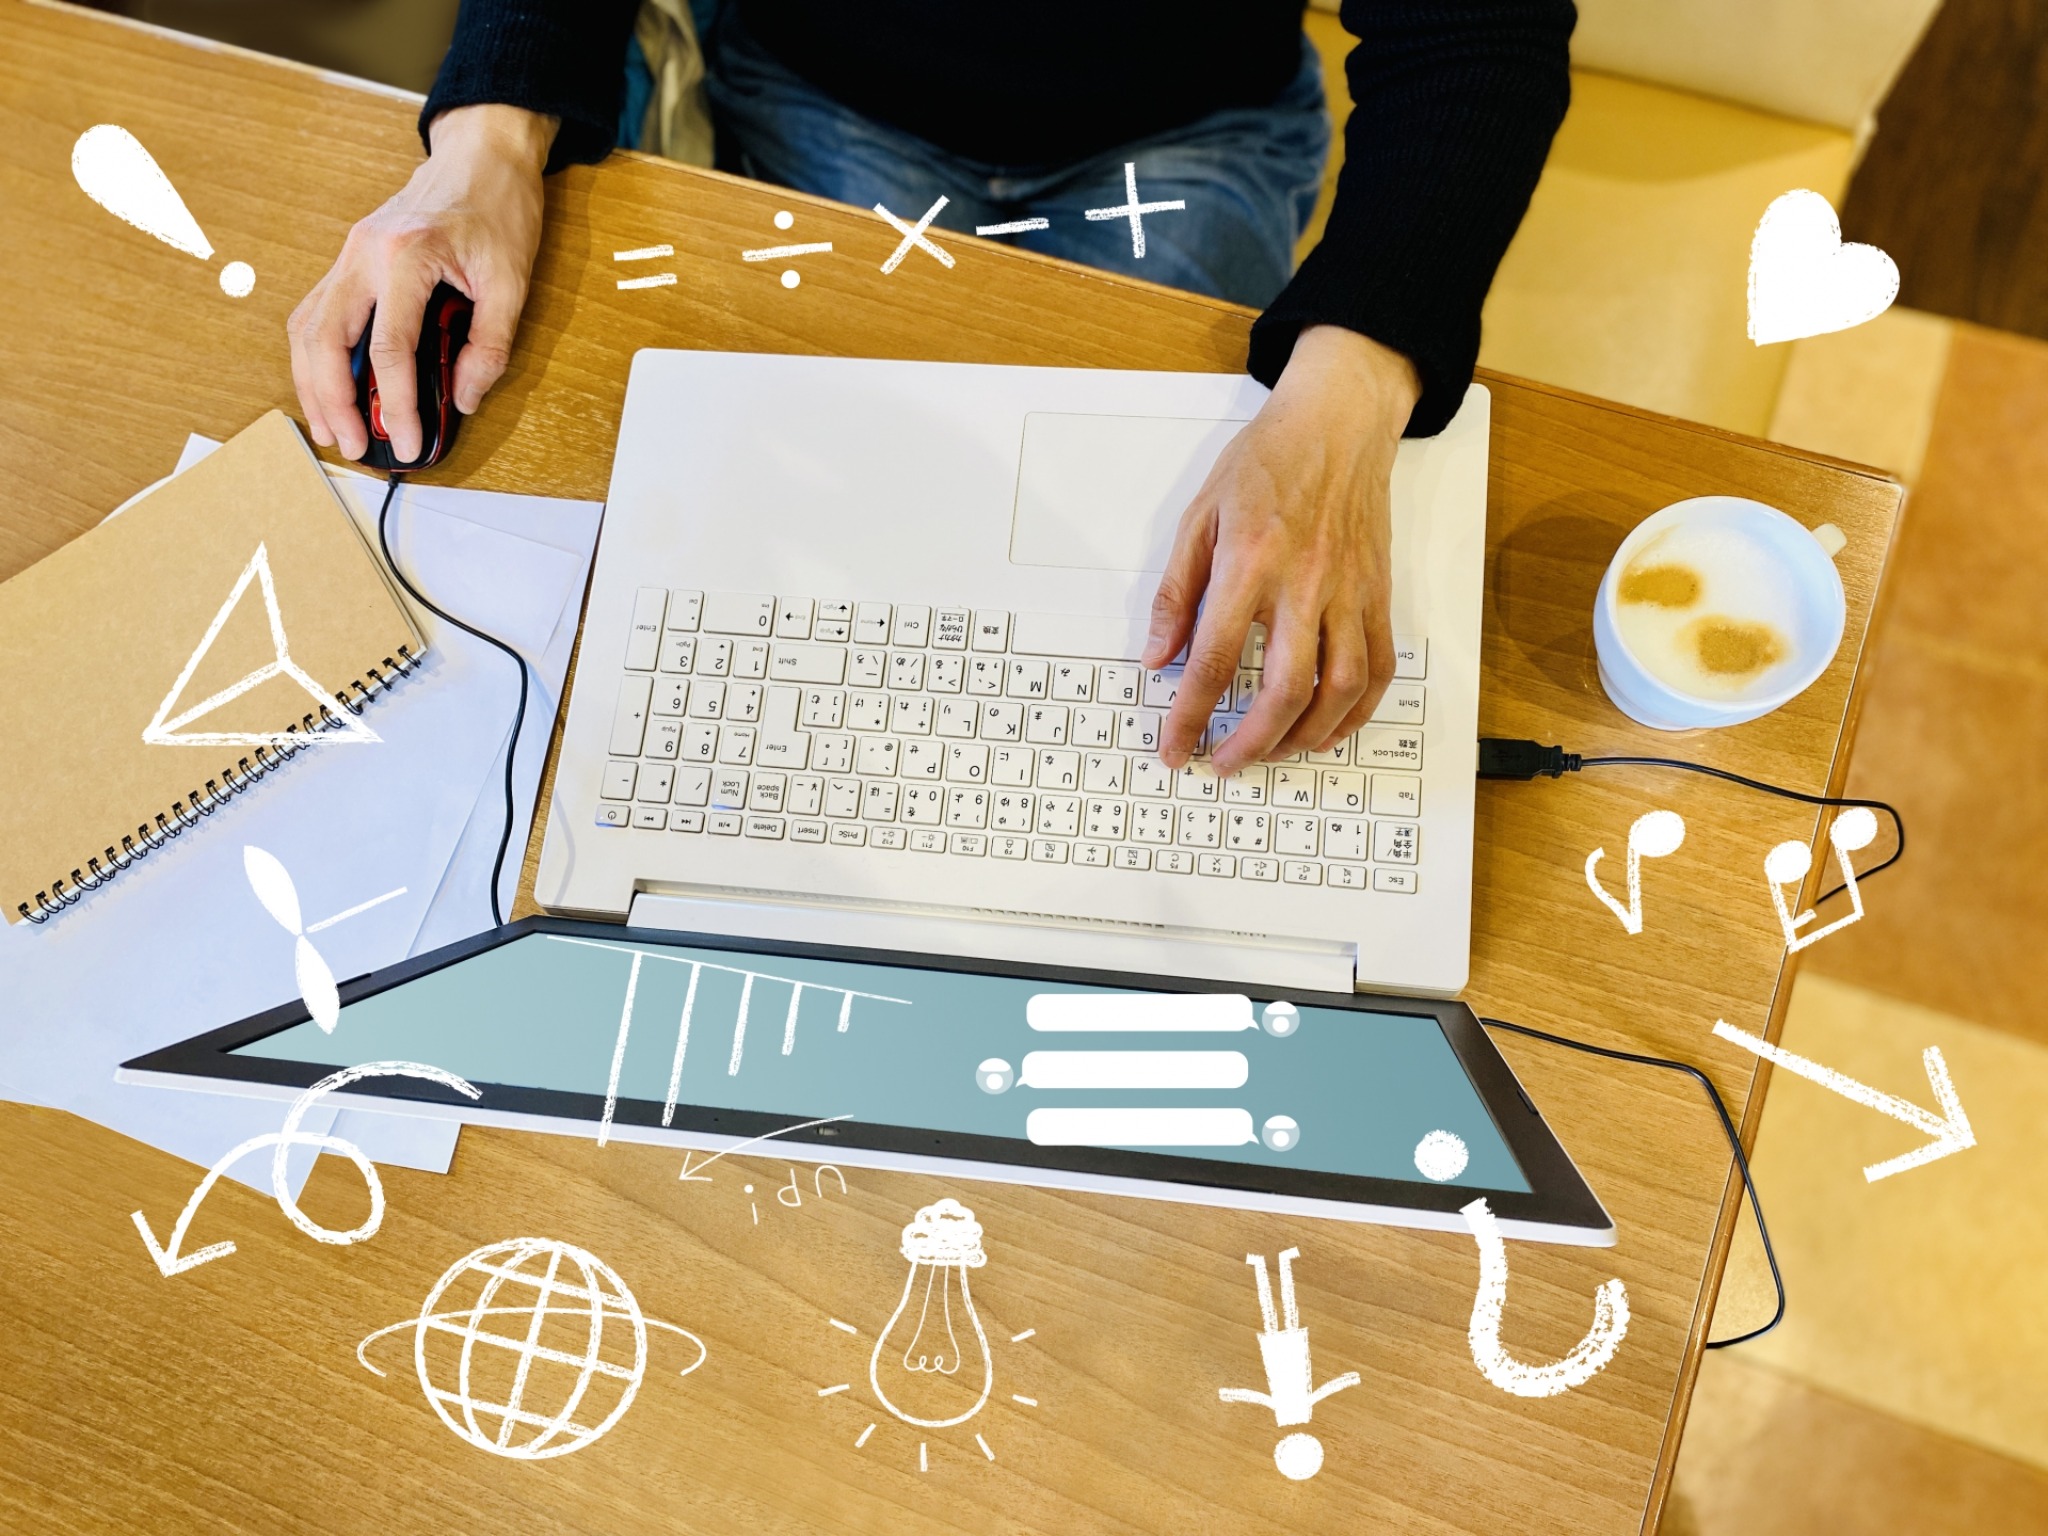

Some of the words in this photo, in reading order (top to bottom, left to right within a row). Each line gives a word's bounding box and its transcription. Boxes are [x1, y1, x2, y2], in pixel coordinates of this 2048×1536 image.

[636, 624, 657, 632] Enter
[904, 621, 919, 629] Ctrl
[939, 623, 963, 633] ひらがな
[938, 634, 962, 642] カタカナ
[679, 655, 688, 668] 3
[778, 657, 797, 666] Shift
[1398, 652, 1414, 660] Ctrl
[715, 658, 724, 670] 2
[754, 661, 759, 672] 1
[1030, 681, 1042, 693] M
[1077, 684, 1087, 695] N
[1123, 687, 1133, 699] B
[672, 698, 681, 709] 6
[708, 700, 717, 712] 5
[746, 703, 754, 715] 4
[1399, 699, 1420, 708] Shift
[963, 720, 971, 732] L
[1006, 723, 1016, 735] K
[1053, 726, 1061, 738] J
[1097, 730, 1107, 741] H
[1142, 733, 1153, 745] G
[665, 740, 674, 753] 9
[701, 743, 710, 755] 8
[738, 746, 746, 758] 7
[766, 744, 787, 753] Enter
[1332, 746, 1344, 758] A
[1372, 747, 1418, 760] CapsLock
[926, 762, 936, 774] P
[1062, 772, 1072, 784] U
[1108, 776, 1118, 788] Y
[722, 781, 740, 790] Lock
[756, 784, 780, 793] space
[1155, 779, 1165, 791] T
[1202, 783, 1213, 795] R
[720, 788, 739, 797] Num
[760, 792, 779, 801] Back
[1251, 786, 1261, 799] E
[1294, 790, 1309, 802] W
[1398, 791, 1415, 801] Tab
[975, 794, 983, 805] 9
[1021, 798, 1029, 809] 8
[1346, 793, 1359, 806] Q
[1066, 802, 1074, 813] 7
[1113, 805, 1121, 816] 6
[1160, 809, 1169, 820] 5
[1208, 813, 1216, 823] 4
[1256, 816, 1264, 828] 3
[1305, 820, 1313, 832] 2
[753, 823, 777, 833] Delete
[797, 827, 819, 836] Insert
[1356, 825, 1361, 835] 1
[838, 830, 858, 839] PrtSc
[1388, 876, 1404, 885] Esc
